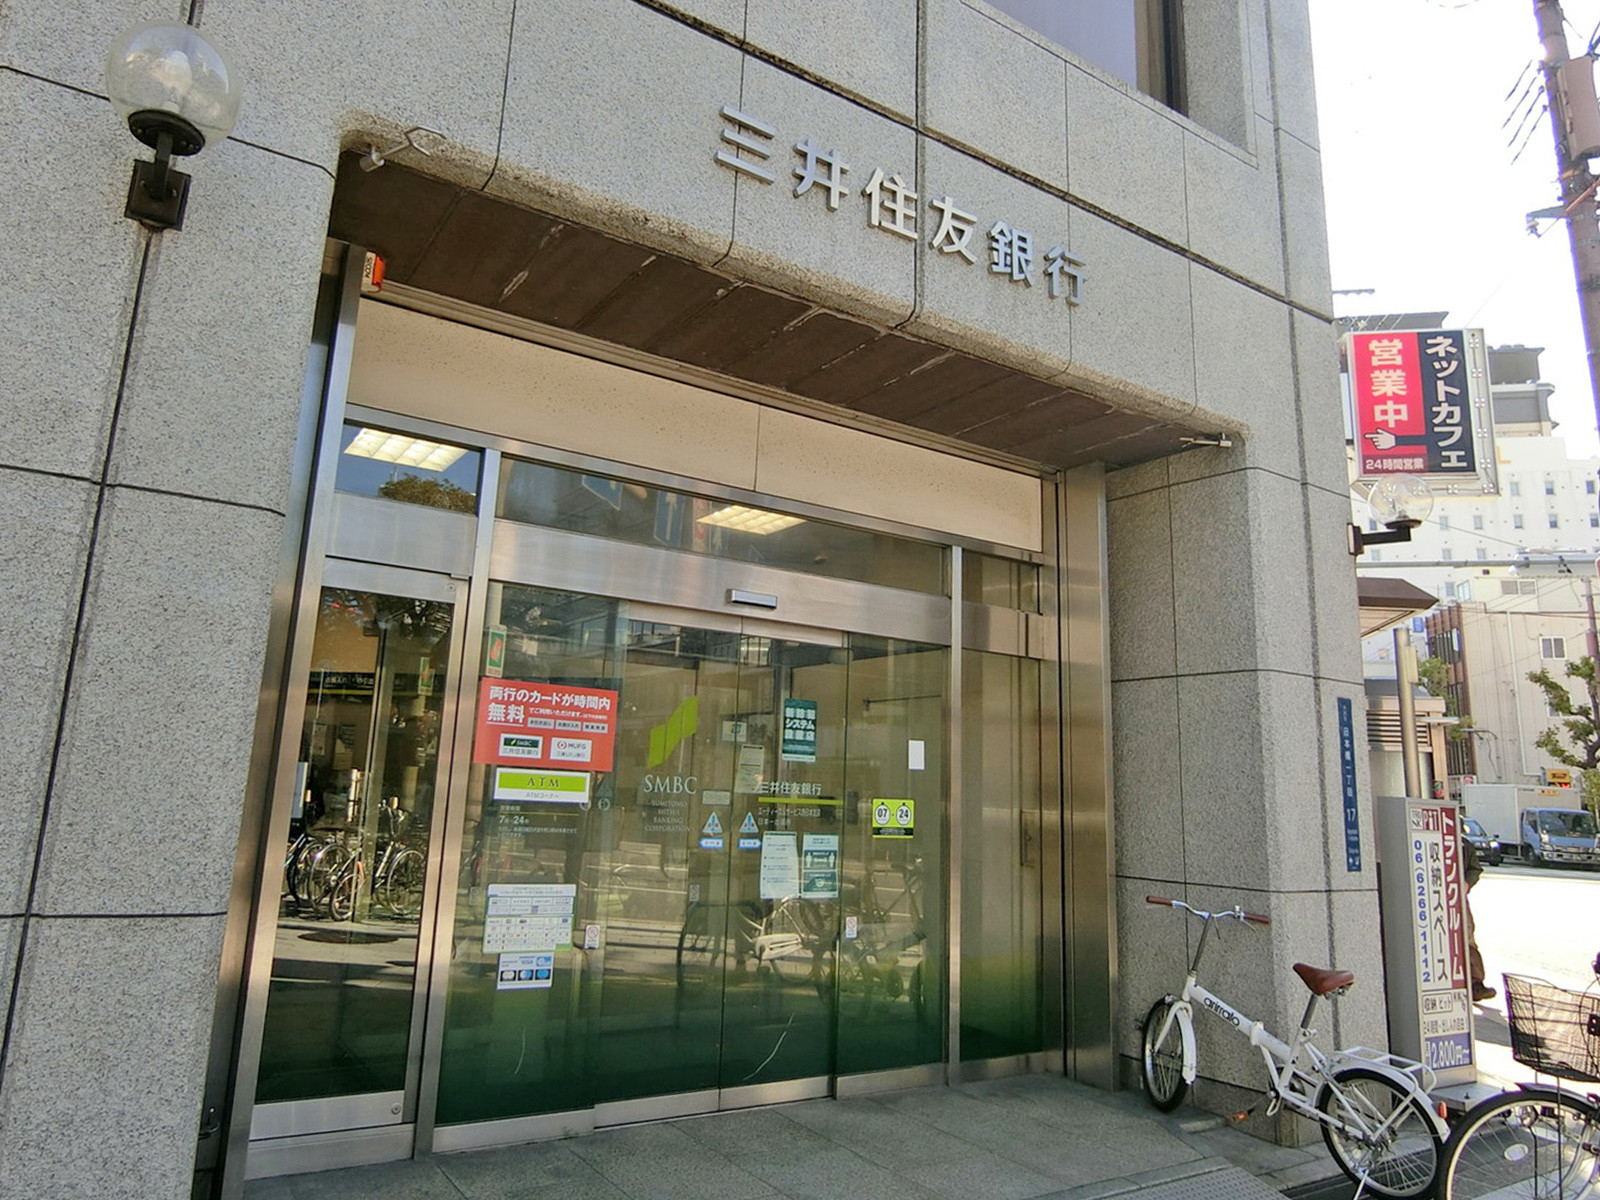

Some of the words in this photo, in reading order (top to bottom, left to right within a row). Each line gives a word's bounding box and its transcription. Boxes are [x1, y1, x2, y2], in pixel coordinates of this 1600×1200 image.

[713, 105, 1088, 304] 三井住友銀行
[1368, 339, 1409, 428] 営業中
[1425, 336, 1467, 468] ネットカフェ
[1365, 458, 1424, 470] 24時間営業
[489, 685, 611, 711] 両行のカードが時間内
[487, 702, 525, 723] 無料
[785, 718, 815, 730] システム
[567, 742, 587, 750] MUFG
[527, 777, 559, 788] ATM
[643, 774, 697, 795] SMBC
[760, 781, 822, 796] 三井住友銀行
[877, 808, 887, 818] 07
[899, 808, 909, 819] 24
[1346, 808, 1356, 822] 17
[1442, 811, 1465, 980] トランクルーム
[1429, 841, 1448, 981] 収納スペース
